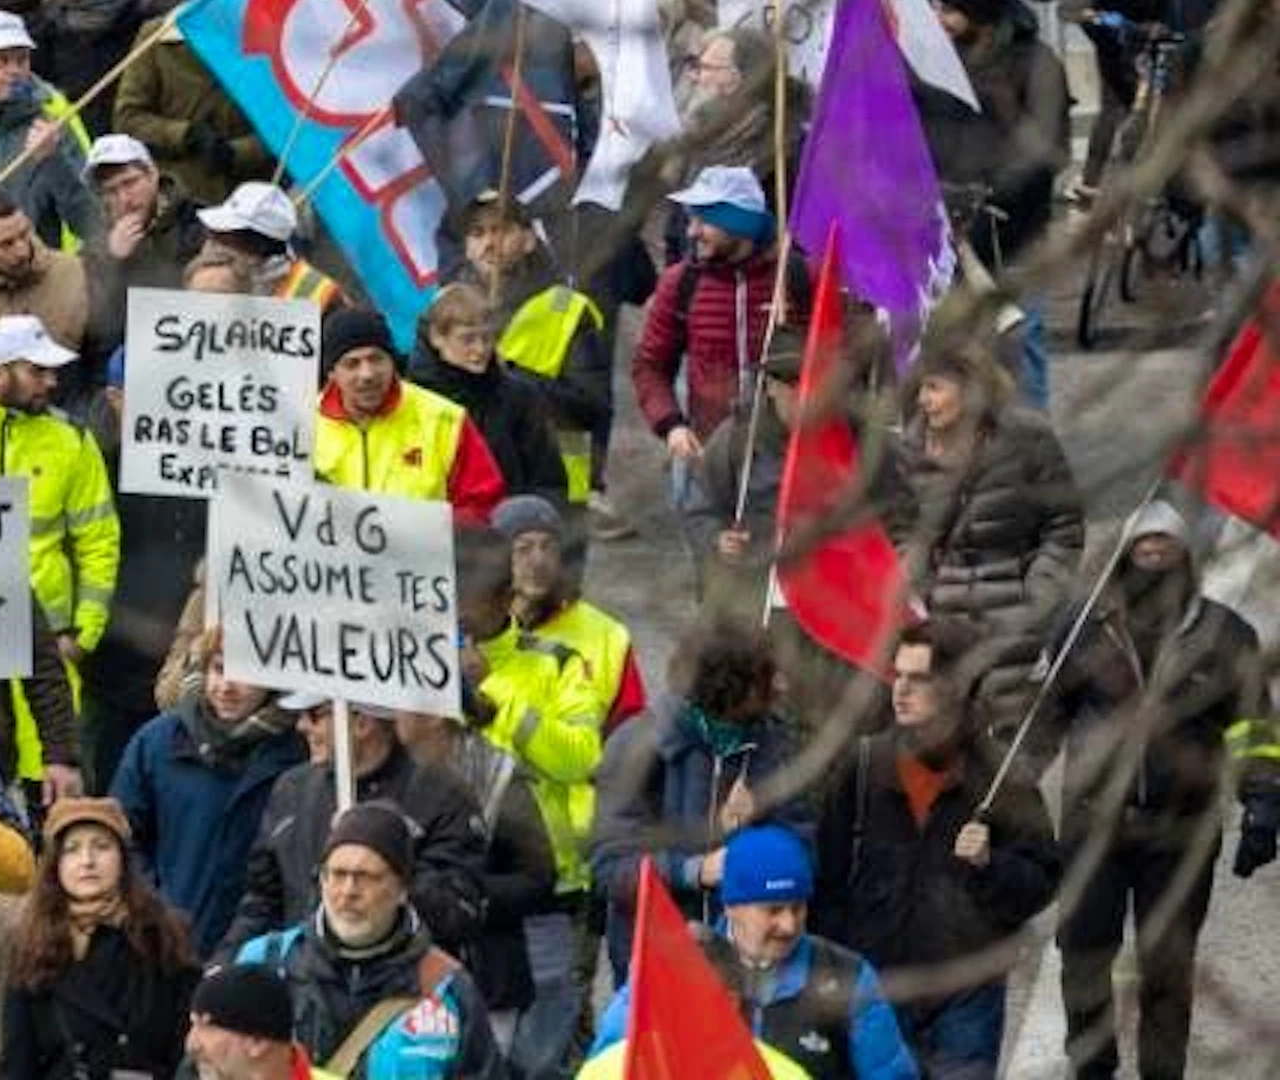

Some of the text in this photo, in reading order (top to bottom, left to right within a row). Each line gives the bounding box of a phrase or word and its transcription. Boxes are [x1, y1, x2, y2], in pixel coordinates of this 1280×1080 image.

[166, 374, 278, 413] GELÉS
[134, 415, 190, 446] RAS
[200, 422, 237, 452] LE
[229, 544, 450, 613] ASSUME TES
[245, 609, 450, 690] VALEURS
